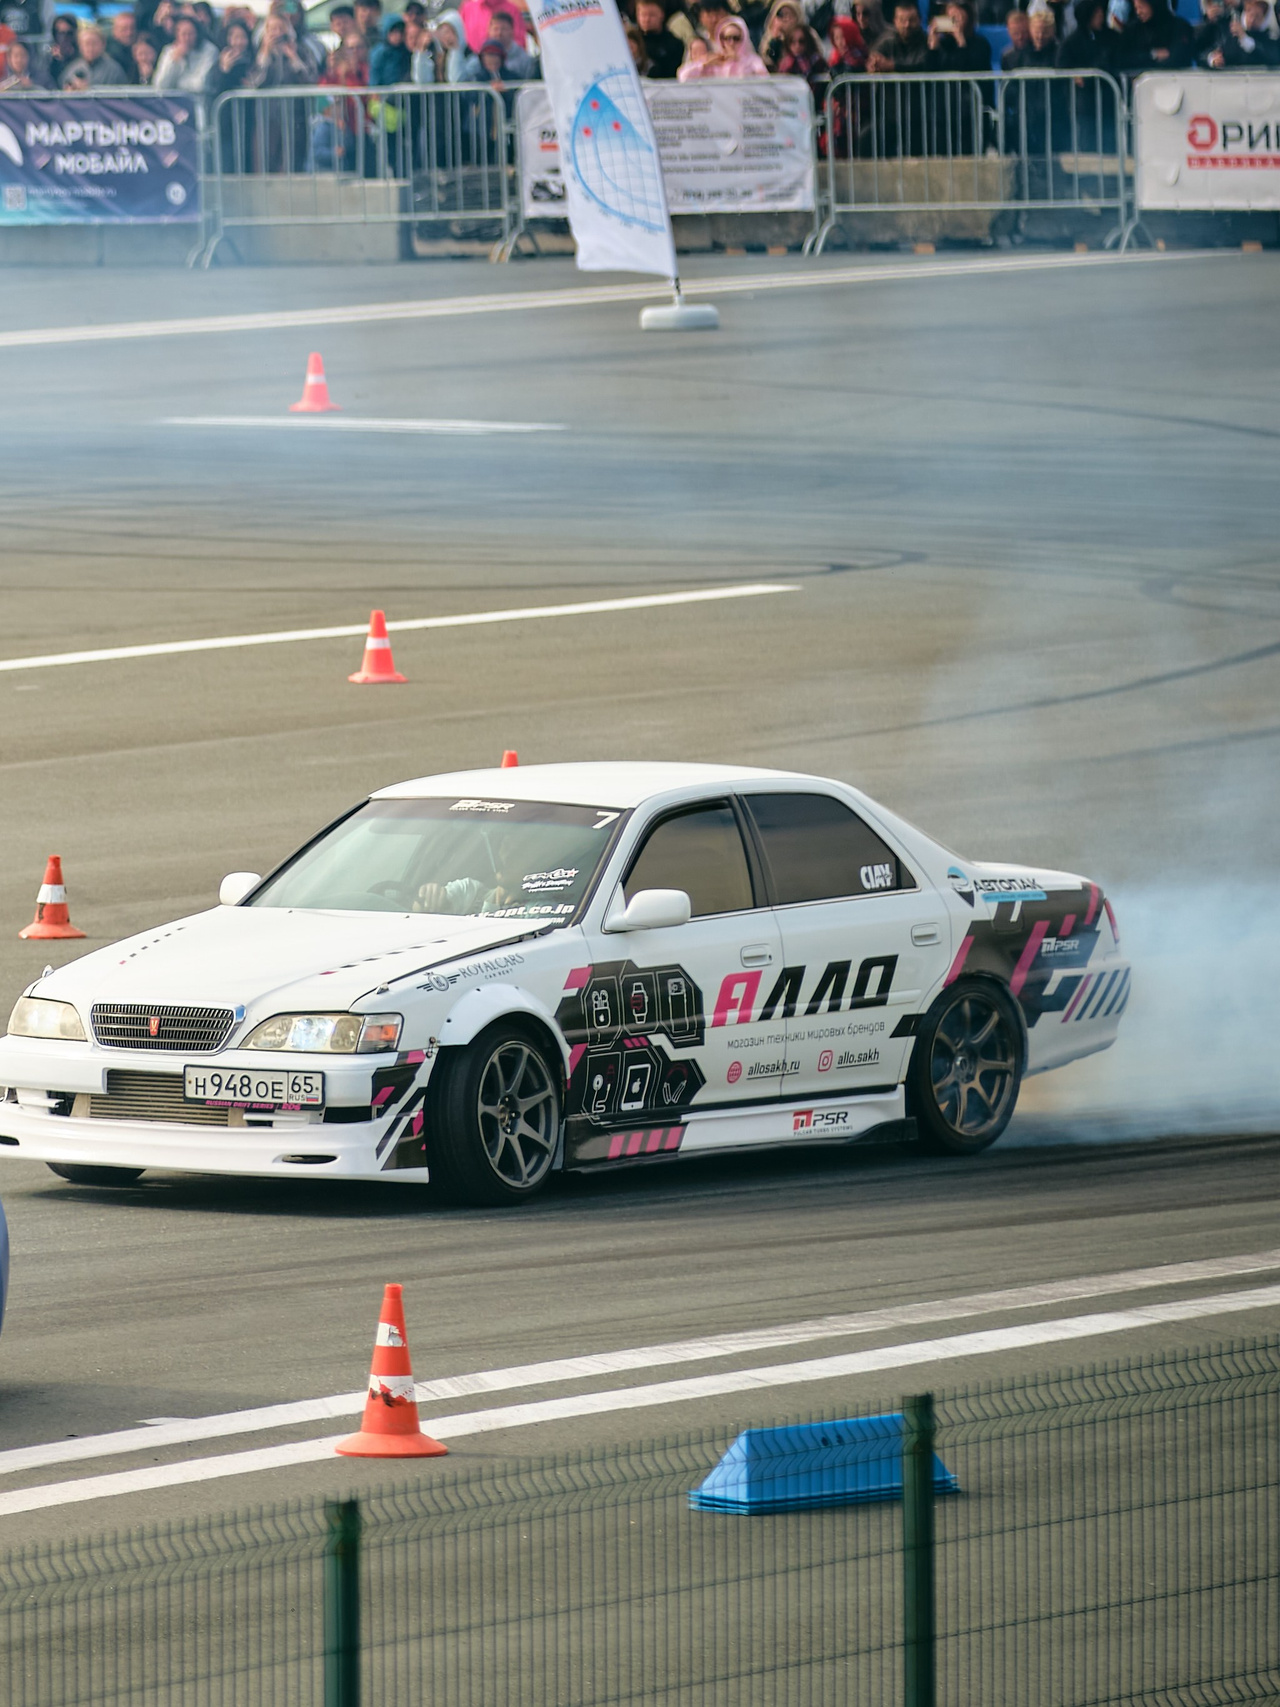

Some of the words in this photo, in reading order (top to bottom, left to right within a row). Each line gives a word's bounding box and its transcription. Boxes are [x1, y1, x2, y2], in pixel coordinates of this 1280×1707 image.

[25, 119, 176, 147] МАРТЫНОВ
[54, 147, 149, 175] МОБАЙЛ
[592, 811, 621, 829] 7
[973, 878, 1044, 892] АВТОПАК
[710, 954, 899, 1028] АЛЛО
[727, 1036, 764, 1049] магазин
[766, 1030, 805, 1044] техники
[807, 1026, 845, 1042] мировых
[848, 1021, 885, 1036] брендов
[837, 1048, 880, 1065] allo.sakh
[747, 1059, 801, 1076] allosakh.ru
[291, 1075, 313, 1094] 65
[205, 1100, 232, 1108] RUSSIAN
[289, 1093, 306, 1102] RUS
[812, 1111, 849, 1126] PSR
